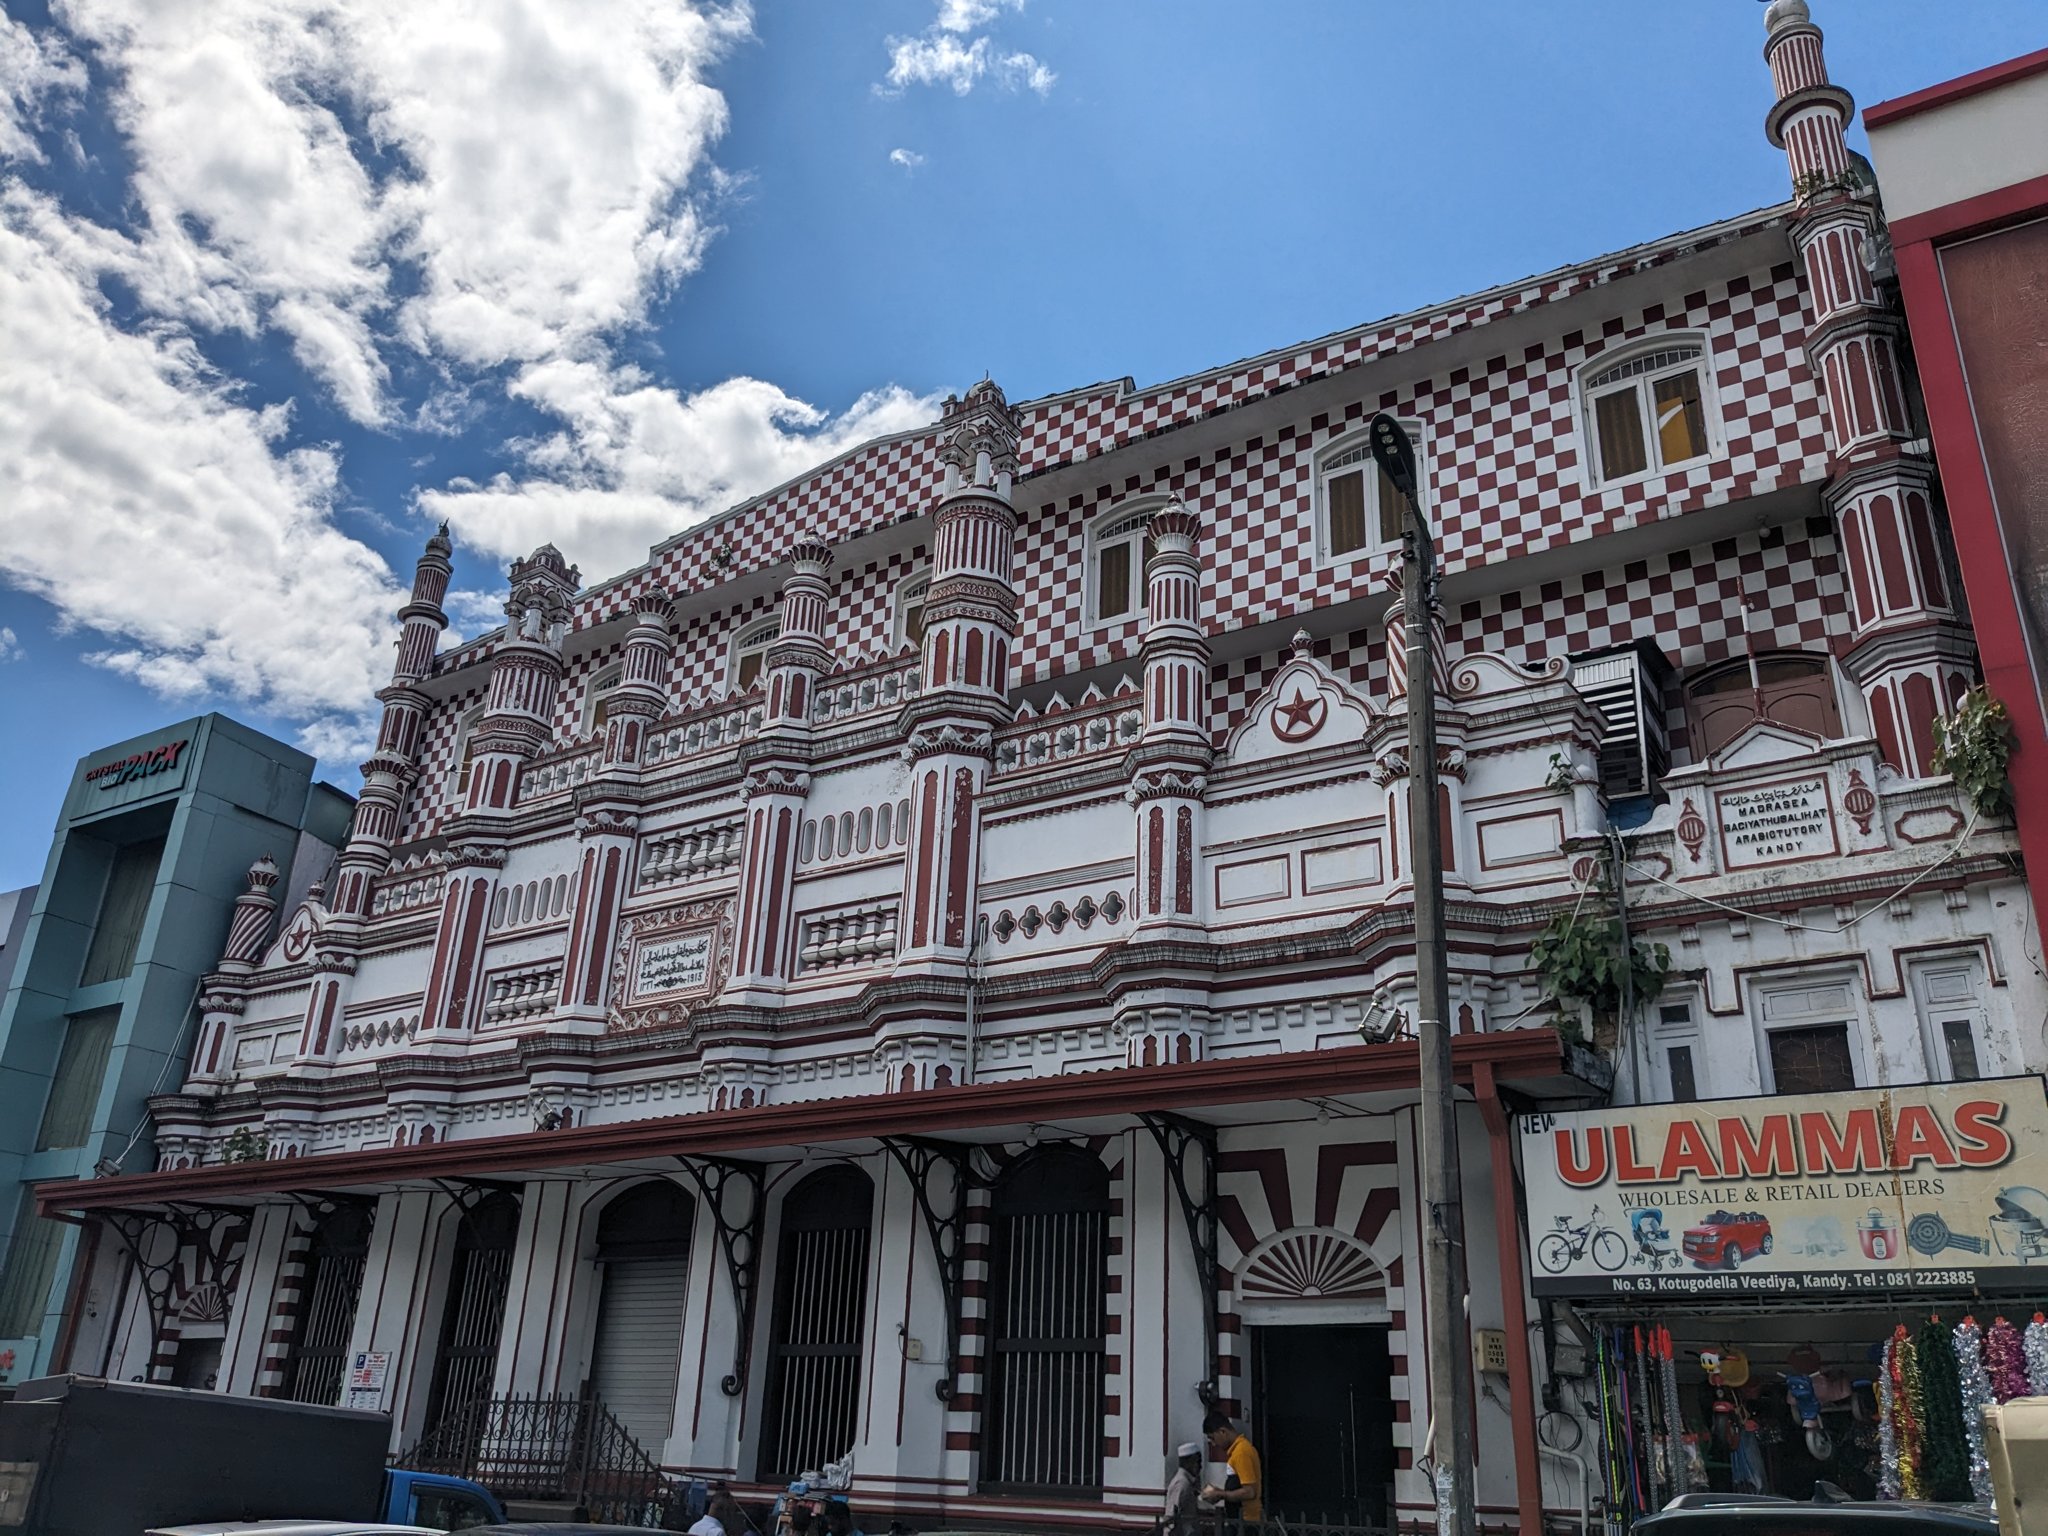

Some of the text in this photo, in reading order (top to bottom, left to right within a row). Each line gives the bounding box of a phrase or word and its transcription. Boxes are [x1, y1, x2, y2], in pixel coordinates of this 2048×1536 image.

[85, 760, 125, 782] CRYSTAL
[118, 740, 188, 785] PACK
[101, 774, 117, 788] BIO
[1739, 798, 1809, 817] MADRASEA
[1756, 841, 1803, 856] KANDY
[1554, 1100, 2010, 1184] ULAMMAS
[1617, 1177, 1946, 1208] WHOLESALE & RETAIL DEALERS
[1612, 1277, 1636, 1291] No.
[1637, 1276, 1657, 1292] 63,
[1658, 1274, 1739, 1293] Kotugodella
[1740, 1274, 1800, 1292] Veediya,
[1802, 1272, 1852, 1291] Kandy.
[1853, 1272, 1877, 1287] Tel
[1886, 1271, 1912, 1286] 081
[1915, 1270, 1976, 1286] 2223885
